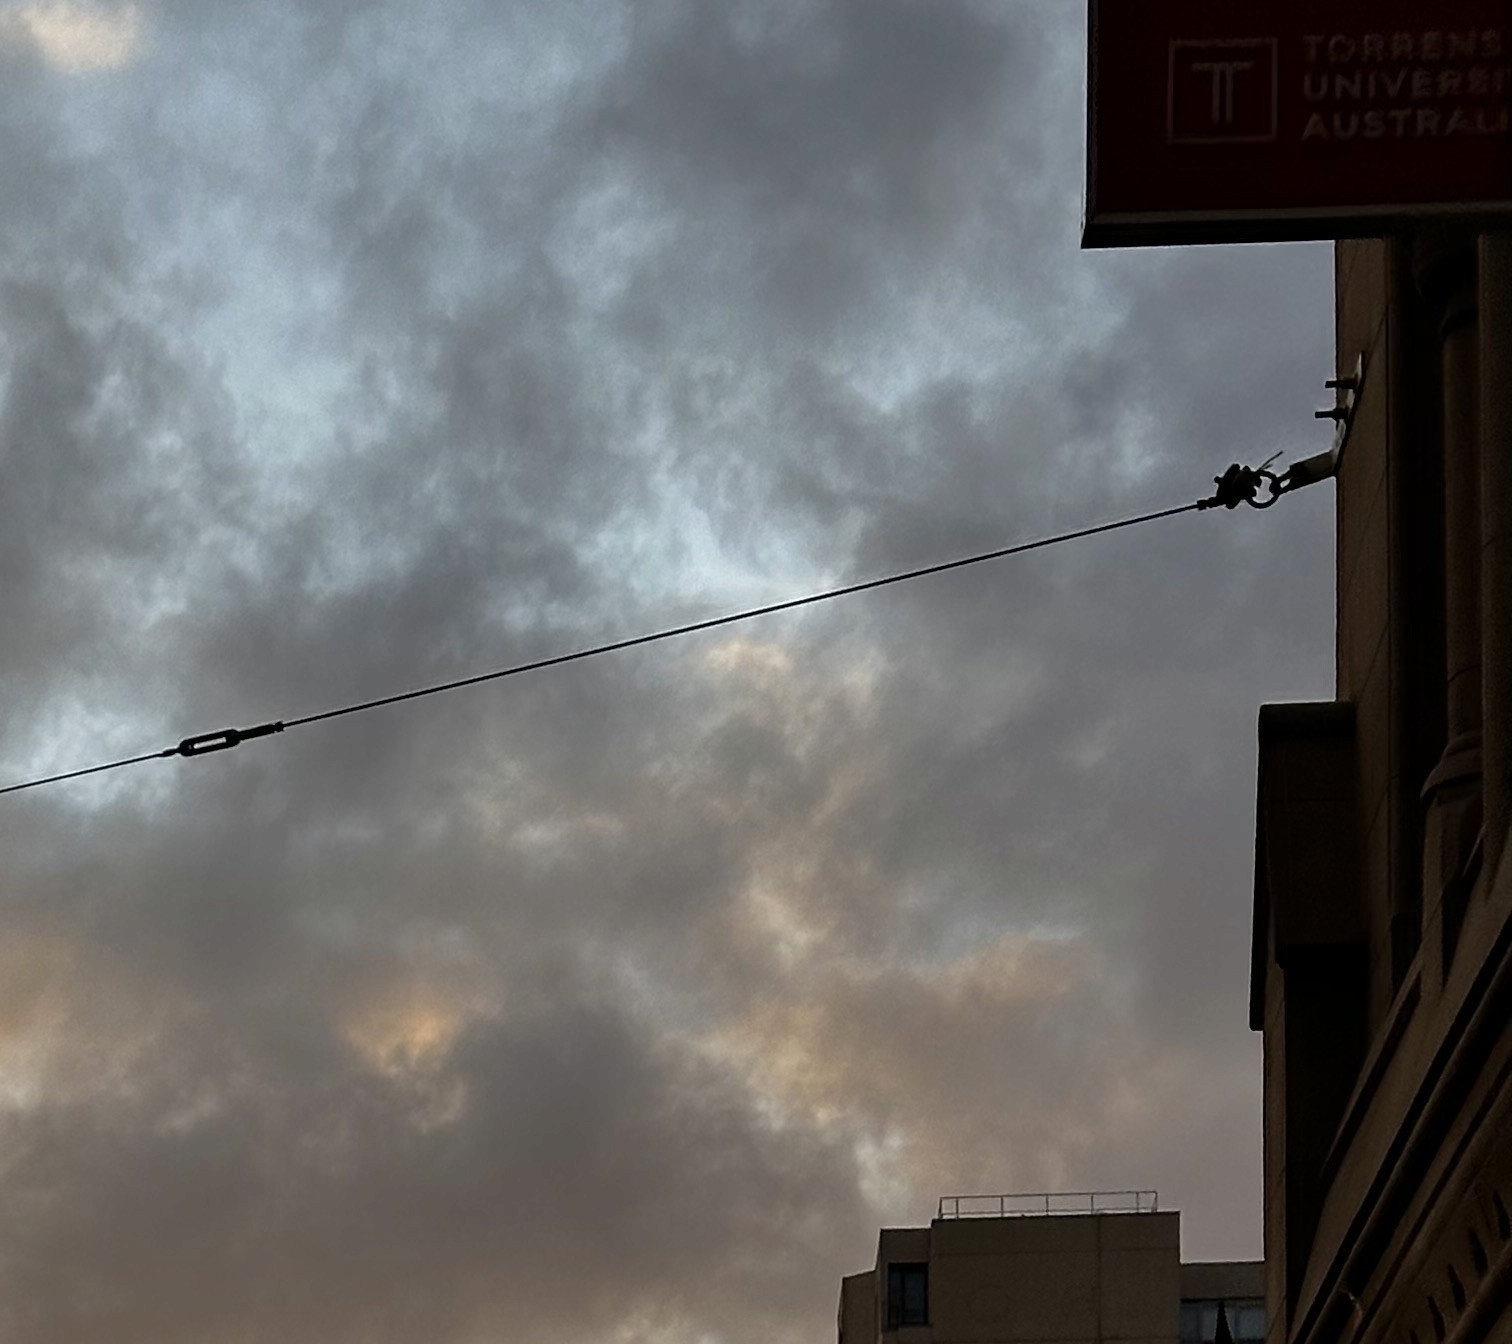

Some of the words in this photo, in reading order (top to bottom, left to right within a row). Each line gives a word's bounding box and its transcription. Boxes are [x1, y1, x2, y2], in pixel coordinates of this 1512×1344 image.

[1302, 28, 1503, 63] TORRENS
[1302, 65, 1512, 102] UNIVERSI
[1300, 106, 1512, 142] AUSTRALI
